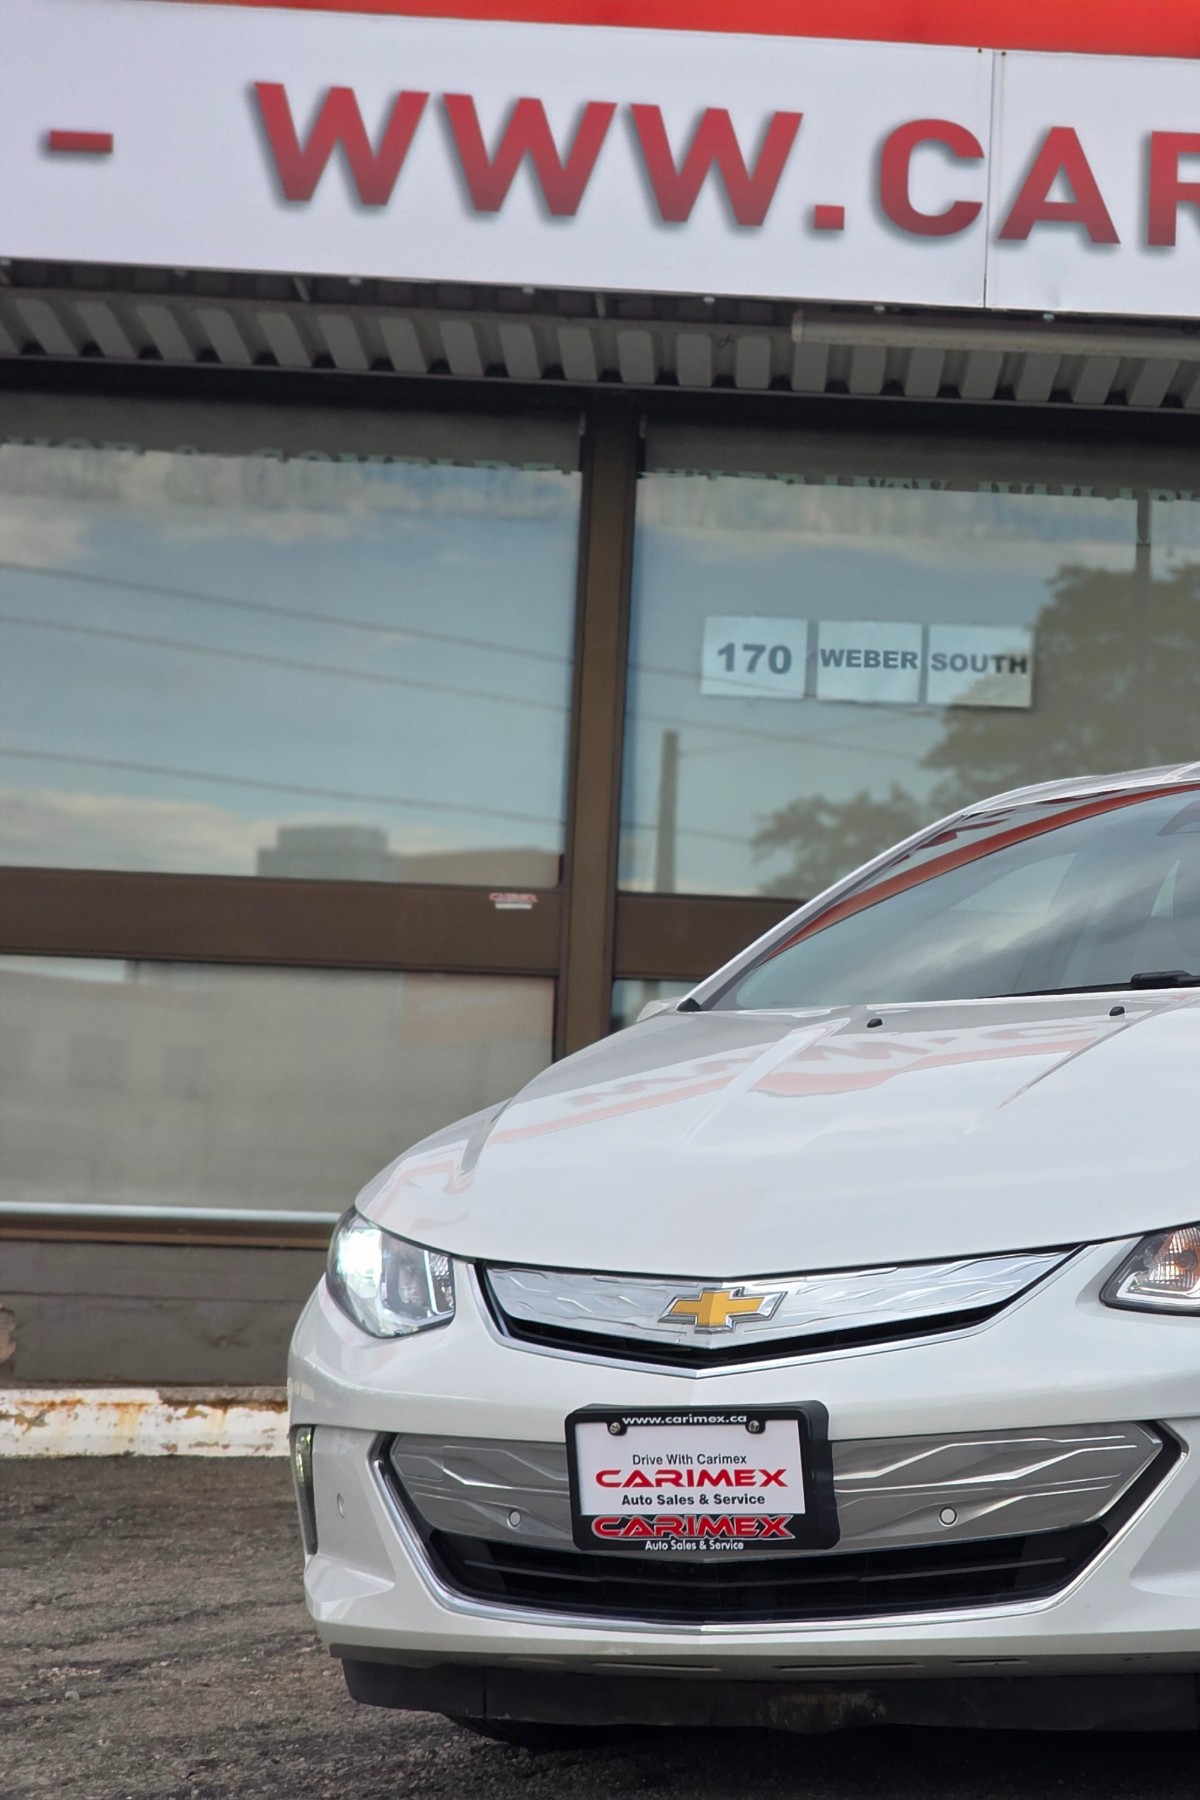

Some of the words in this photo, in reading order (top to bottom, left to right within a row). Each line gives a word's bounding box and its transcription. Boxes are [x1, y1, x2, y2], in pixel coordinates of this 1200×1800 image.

[717, 642, 792, 675] 170
[820, 648, 918, 670] WEBER
[931, 653, 1028, 675] SOUTH
[622, 1413, 748, 1425] www.carimex.ca
[632, 1454, 663, 1466] Drive
[666, 1453, 693, 1465] With
[696, 1453, 747, 1465] Carimex
[595, 1469, 788, 1488] CARIMEX
[621, 1494, 653, 1506] Auto
[656, 1494, 695, 1506] Sales
[699, 1494, 709, 1505] &
[713, 1493, 766, 1505] Service
[592, 1515, 796, 1539] CARIMEX
[645, 1540, 668, 1551] Auto
[670, 1540, 696, 1551] Sales
[699, 1540, 707, 1550] &
[709, 1539, 744, 1551] Service
